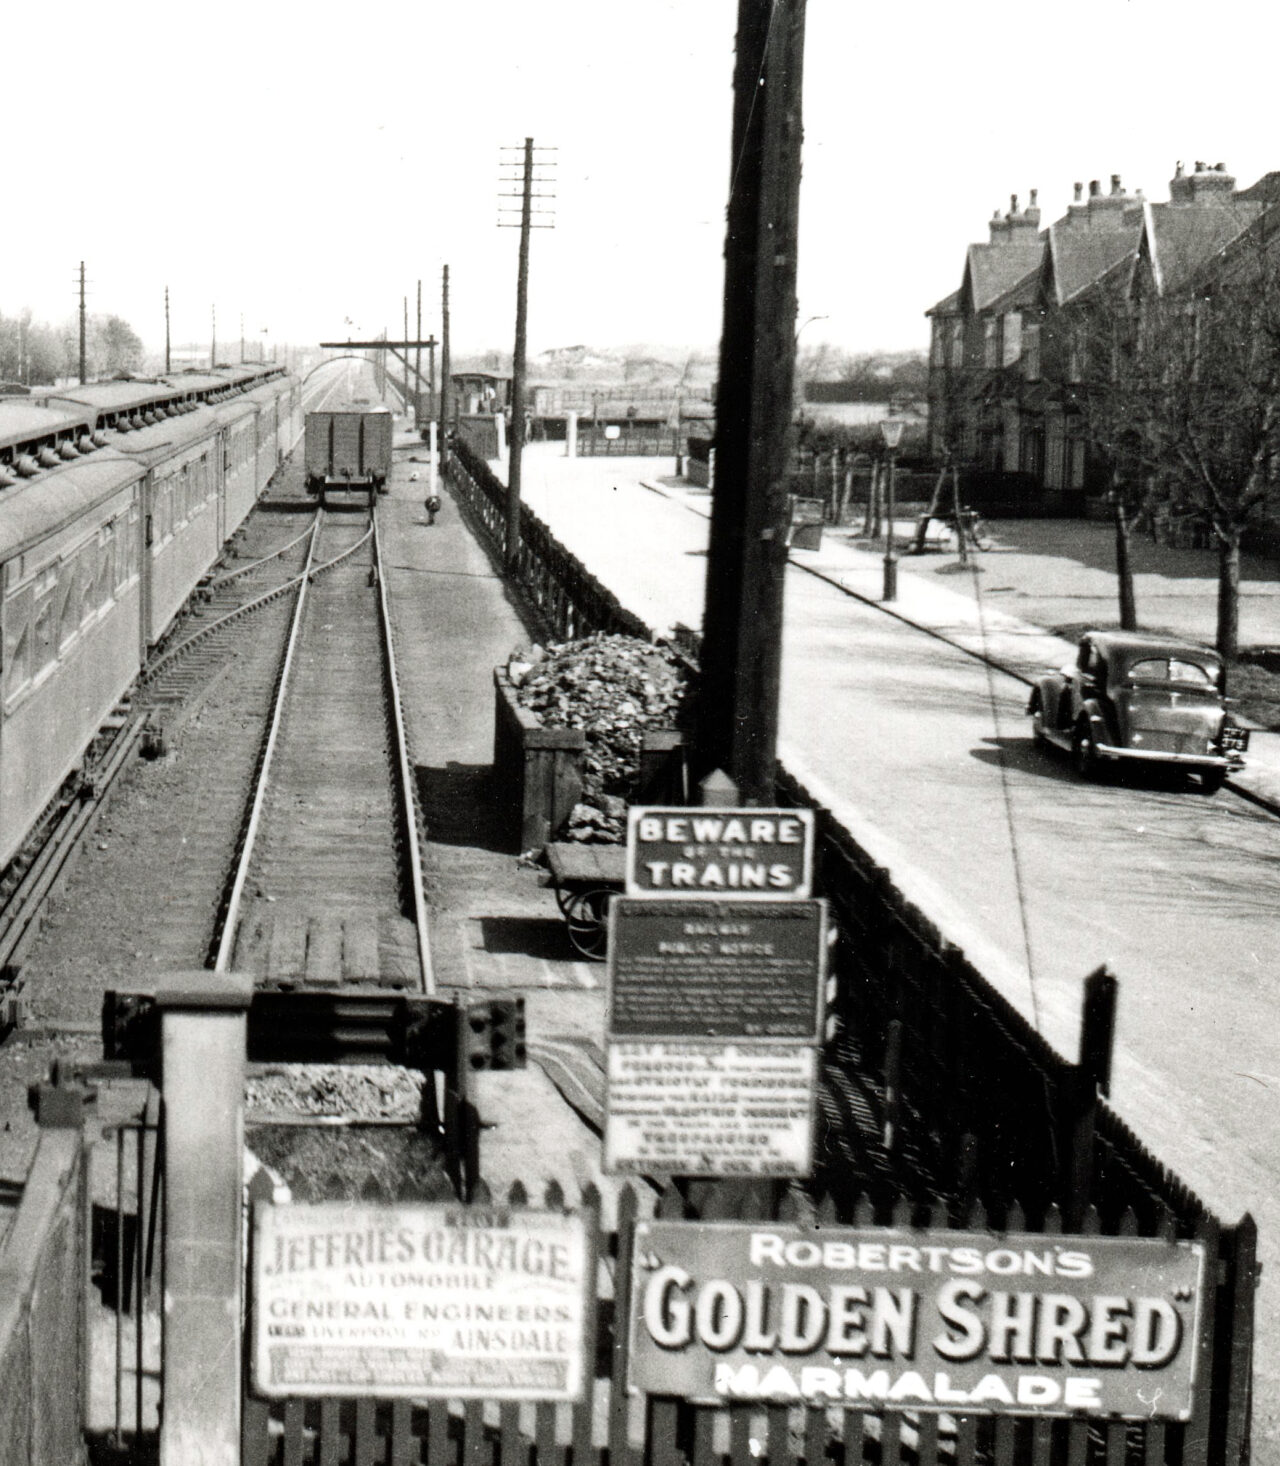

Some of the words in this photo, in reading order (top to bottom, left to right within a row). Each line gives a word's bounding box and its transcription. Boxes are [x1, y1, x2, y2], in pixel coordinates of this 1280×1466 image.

[638, 816, 802, 843] BEWARE
[682, 846, 707, 858] OF
[719, 846, 756, 859] THE
[646, 861, 793, 888] TRAINS
[719, 942, 775, 956] NOTICE
[264, 1228, 417, 1277] JEFFRIES
[749, 1233, 1094, 1278] ROBERTSON'S
[344, 1272, 496, 1290] AUTOMOBILE
[269, 1298, 392, 1321] GENERAL
[404, 1302, 573, 1323] ENGINEERS
[451, 1327, 568, 1353] AINSDALE
[715, 1362, 1102, 1407] MARMALADE
